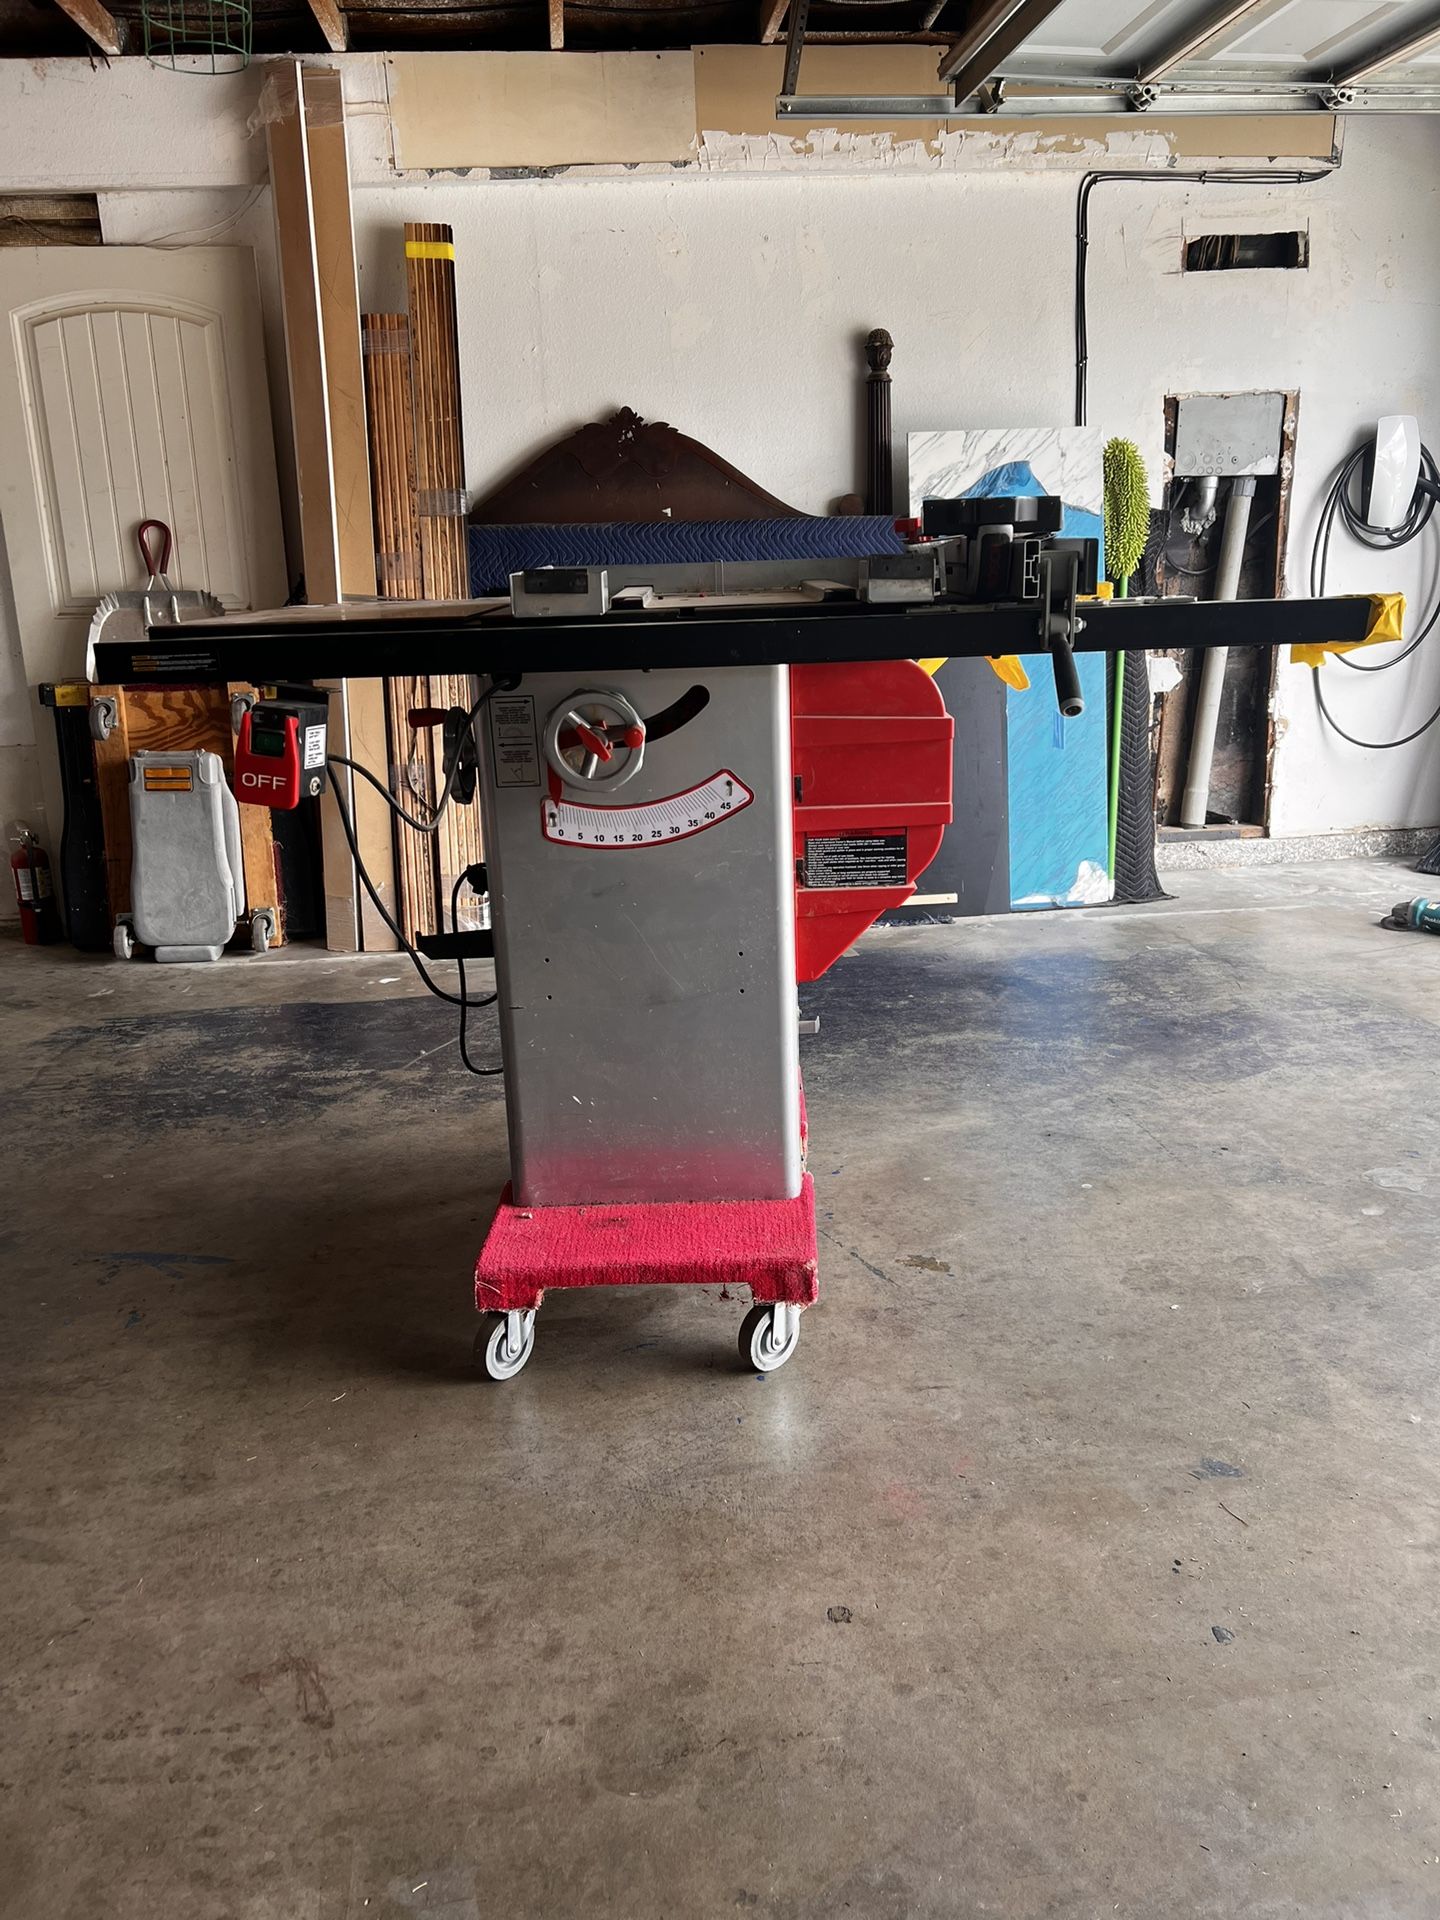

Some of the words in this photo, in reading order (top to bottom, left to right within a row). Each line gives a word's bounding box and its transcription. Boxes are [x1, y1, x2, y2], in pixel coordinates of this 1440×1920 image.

[242, 773, 287, 790] OFF
[558, 829, 564, 837] 0
[577, 832, 584, 840] 5
[594, 834, 605, 842] 10
[613, 834, 624, 842] 15
[631, 834, 643, 842] 20
[651, 830, 663, 838] 25
[669, 826, 680, 834] 30
[687, 819, 698, 827] 35
[704, 811, 715, 820] 40
[720, 801, 732, 810] 45
